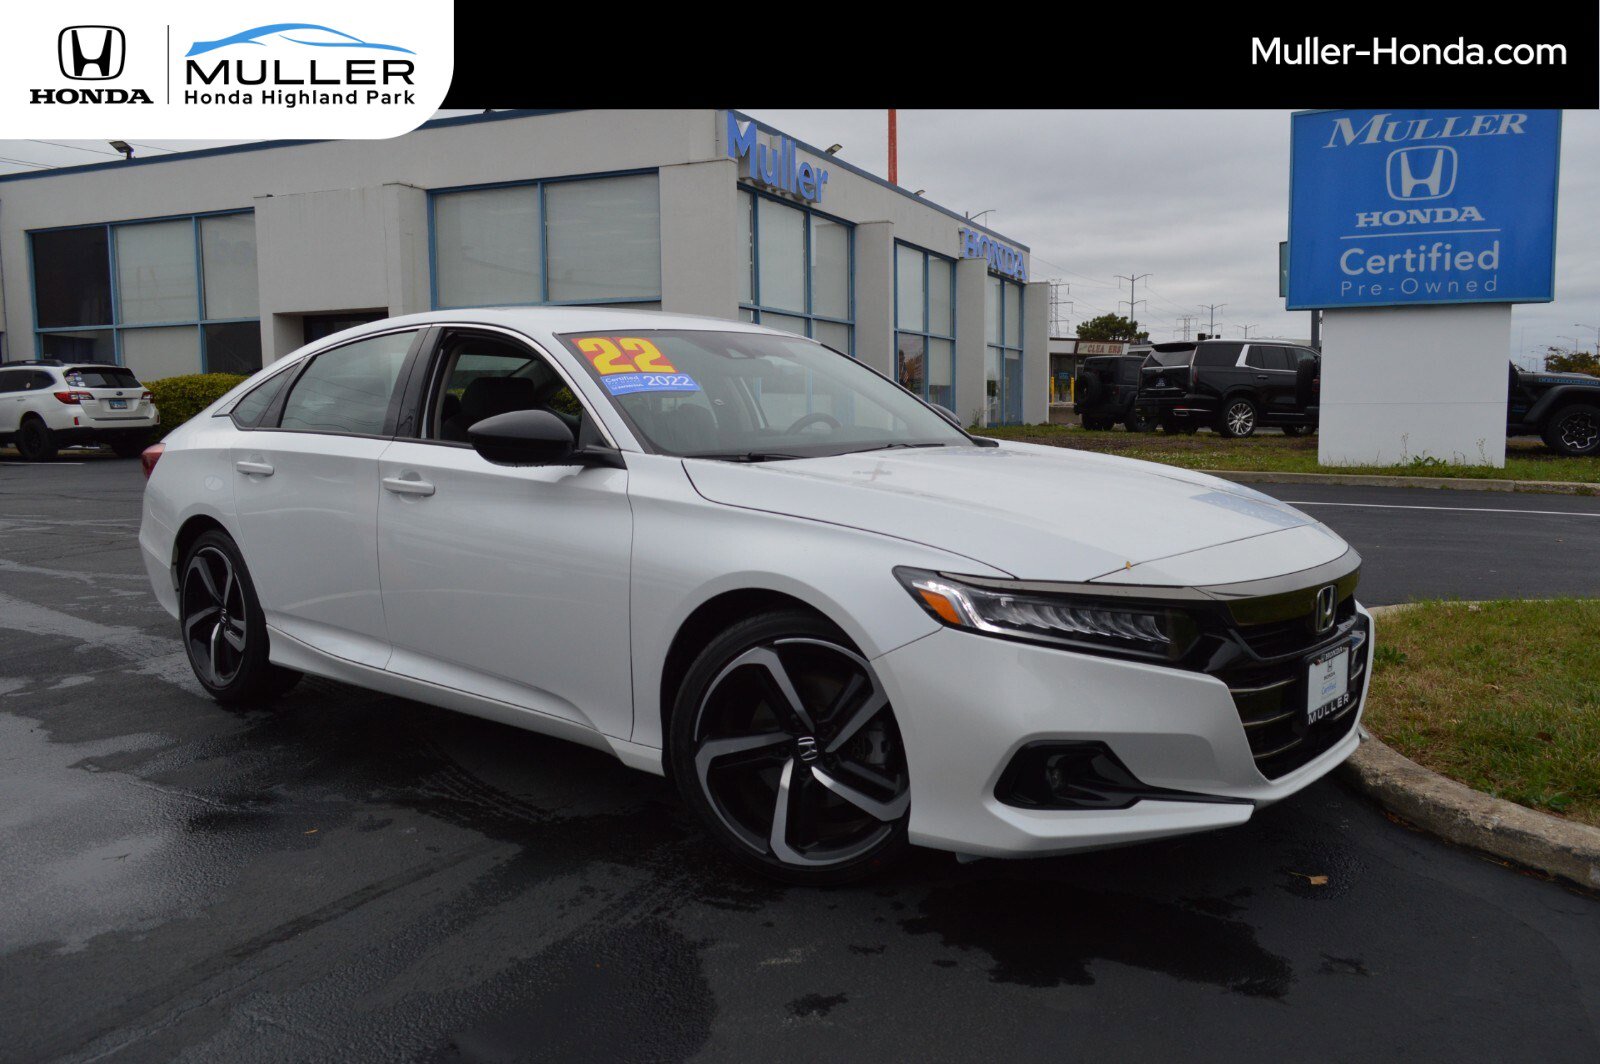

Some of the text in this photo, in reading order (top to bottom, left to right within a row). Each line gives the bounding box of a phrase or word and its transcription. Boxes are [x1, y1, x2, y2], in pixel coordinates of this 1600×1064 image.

[1322, 113, 1528, 149] MULLER
[727, 110, 829, 204] Muller
[1355, 206, 1485, 228] HONDA
[961, 227, 1027, 281] HONDA
[1339, 240, 1500, 276] Certified
[1340, 275, 1498, 297] Pre-Owned
[578, 337, 677, 374] 22
[643, 375, 693, 386] 2022
[1308, 693, 1349, 725] MULLER
